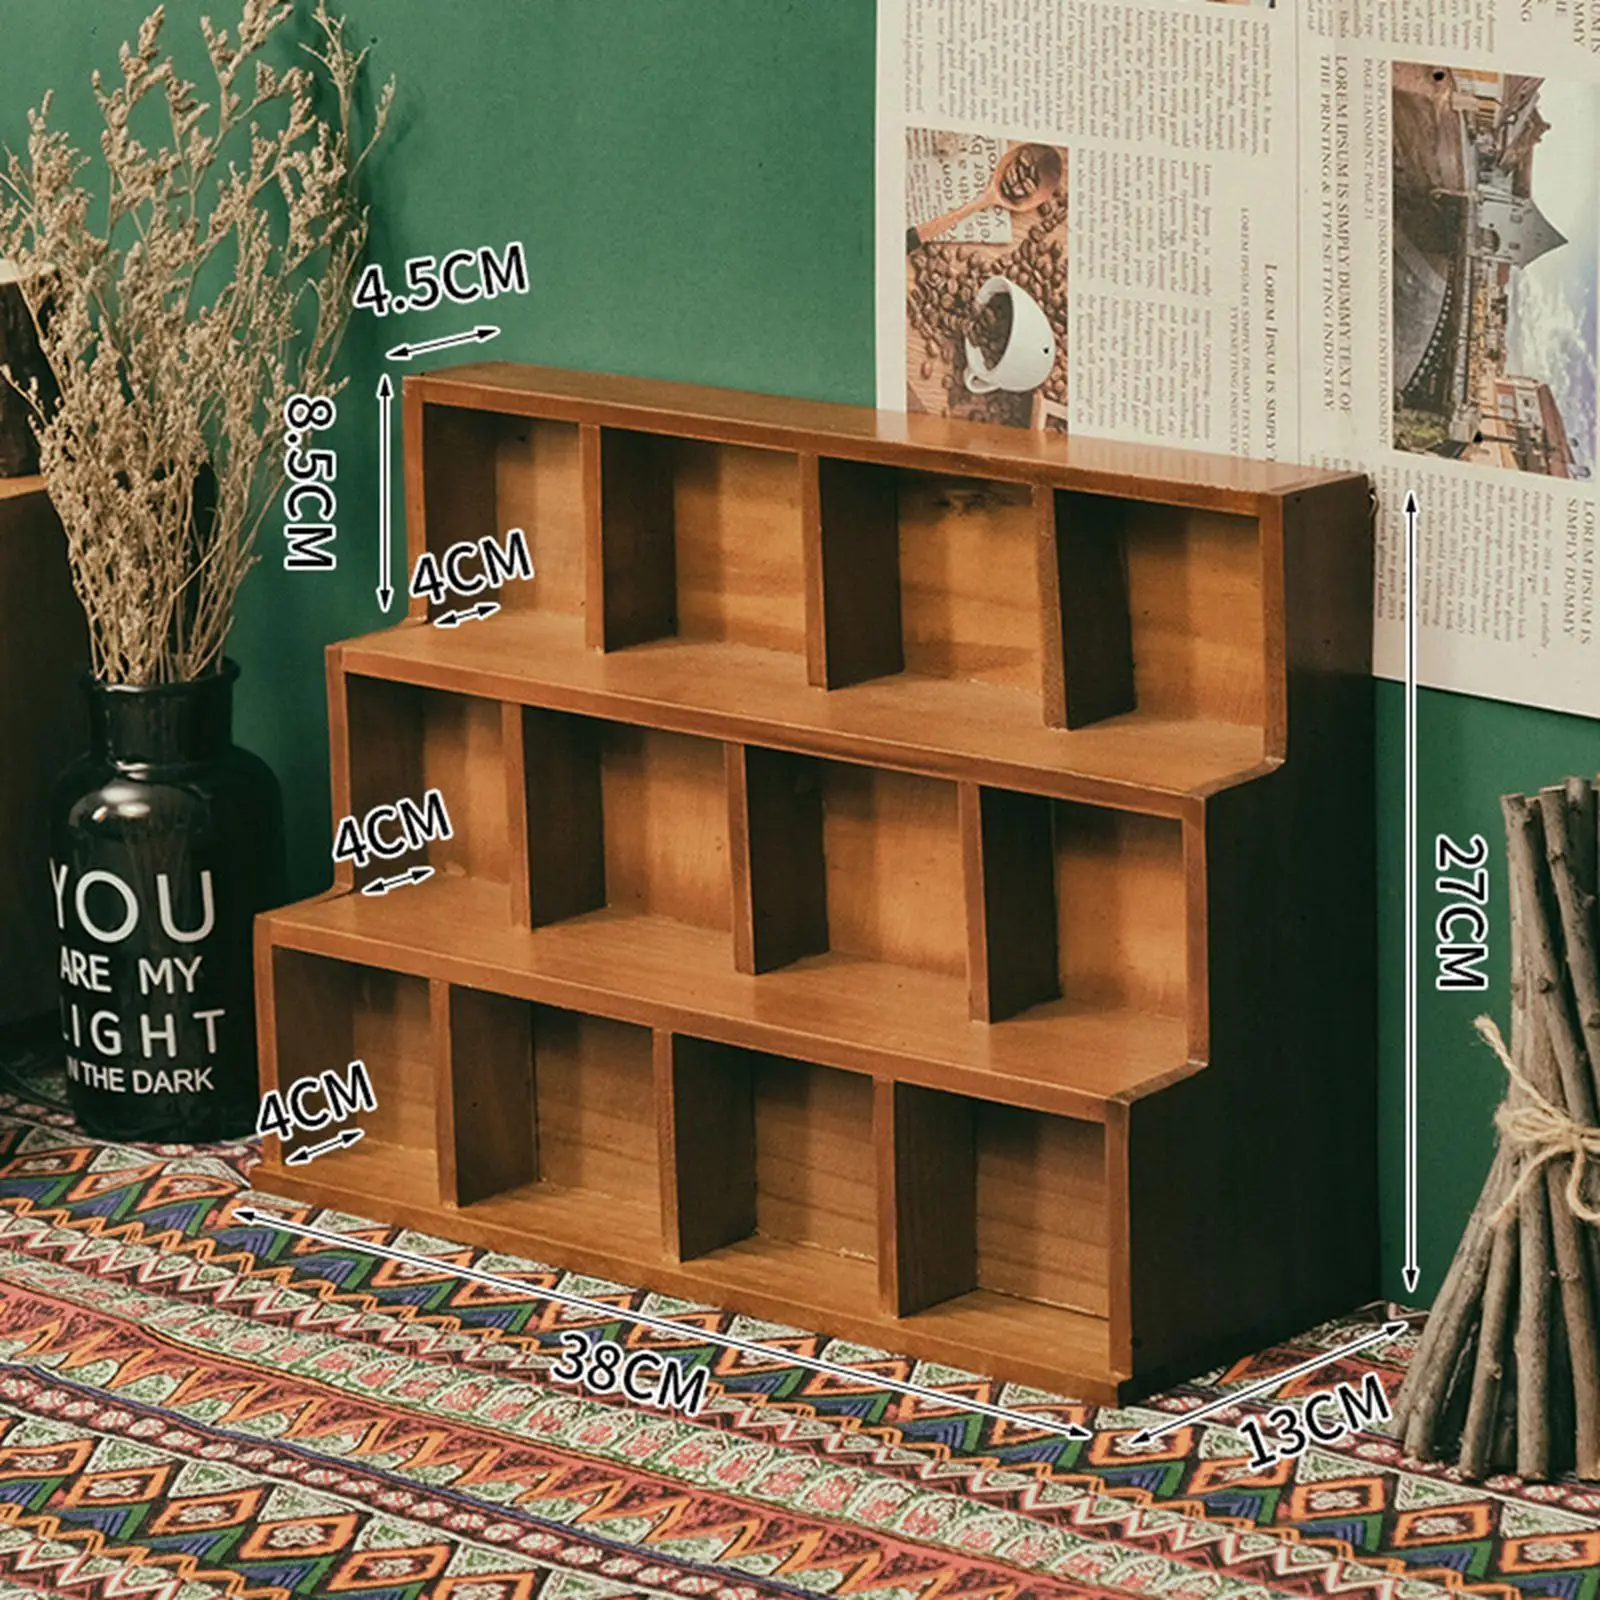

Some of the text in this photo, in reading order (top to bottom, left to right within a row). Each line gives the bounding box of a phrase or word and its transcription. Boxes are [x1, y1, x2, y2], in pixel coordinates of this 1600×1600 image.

[1590, 38, 1600, 54] IS
[1363, 58, 1374, 89] PAGE
[1378, 59, 1388, 80] NO
[1363, 172, 1374, 202] PAGE
[1378, 190, 1388, 218] FOR
[1240, 208, 1250, 252] LOREM
[1320, 54, 1335, 412] THE PRINTING & TYPESETTING INDUSTRY
[1335, 55, 1353, 417] LOREM IPSUM IS SIMPLY DUMMY TEXT OF
[1378, 219, 1388, 266] INDIAN
[1240, 254, 1250, 294] IPSUM
[1241, 296, 1250, 307] IS
[1241, 310, 1250, 353] SIMPLY
[1241, 356, 1251, 404] DUMMY
[1230, 390, 1238, 453] INDUSTRY
[1241, 408, 1251, 439] TEXT
[1563, 498, 1578, 637] SIMPLY DUMMY
[1580, 500, 1595, 646] LOREM IPSUM IS
[50, 857, 215, 943] YOU
[60, 945, 203, 995] ARE MY
[80, 1060, 126, 1092] THE
[132, 1066, 215, 1094] DARK
